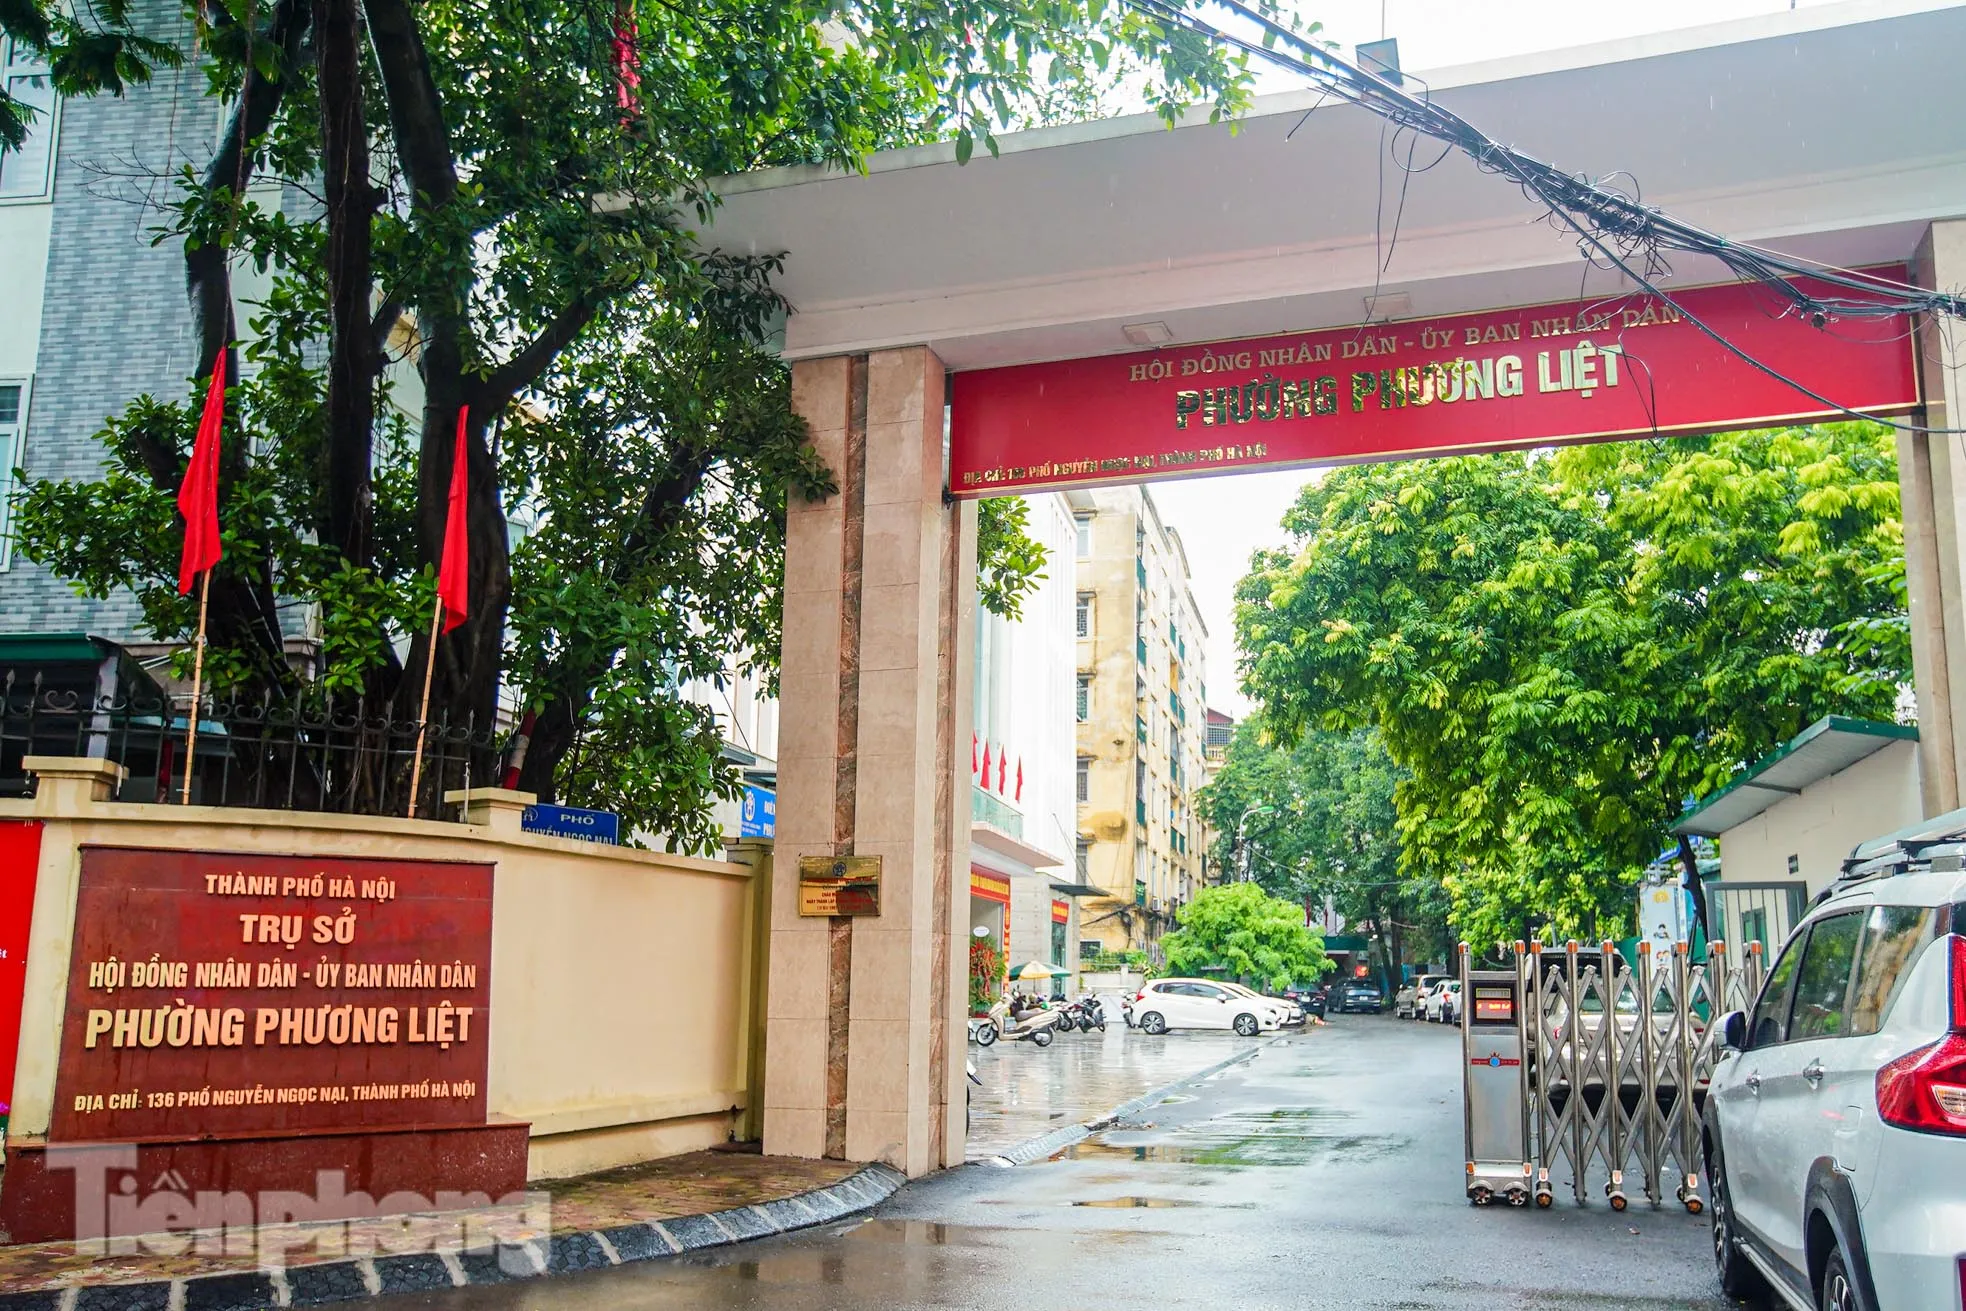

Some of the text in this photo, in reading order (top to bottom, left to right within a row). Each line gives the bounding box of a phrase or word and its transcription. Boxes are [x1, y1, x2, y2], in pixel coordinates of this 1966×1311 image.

[1129, 358, 1173, 383] HỘI
[1181, 348, 1252, 376] ĐỒNG
[1259, 342, 1332, 368] NHÂN
[1341, 335, 1397, 359] DÂN
[1420, 326, 1455, 350] ỦY
[1464, 322, 1521, 345] BAN
[1175, 340, 1623, 430] PHƯỜNG PHƯƠNG LIỆT
[560, 813, 595, 825] PHỐ
[205, 871, 396, 902] THÀNH PHỐ HÀ NỘI
[240, 906, 357, 949] TRỤ SỞ
[88, 956, 126, 993] HỘI
[131, 953, 188, 988] ĐỒNG
[195, 957, 251, 988] NHÂN
[257, 957, 297, 988] DÂN
[315, 955, 341, 988] ỦY
[345, 963, 383, 988] BAN
[386, 959, 436, 988] NHÂN
[440, 959, 476, 988] DÂN
[85, 998, 473, 1049] PHƯỜNG PHƯƠNG LIỆT
[74, 1078, 476, 1114] ĐỊA CHỈ: 136 PHỐ NGUYỄN NGỌC NẠI, THÀNH PHỐ HÀ NỘI
